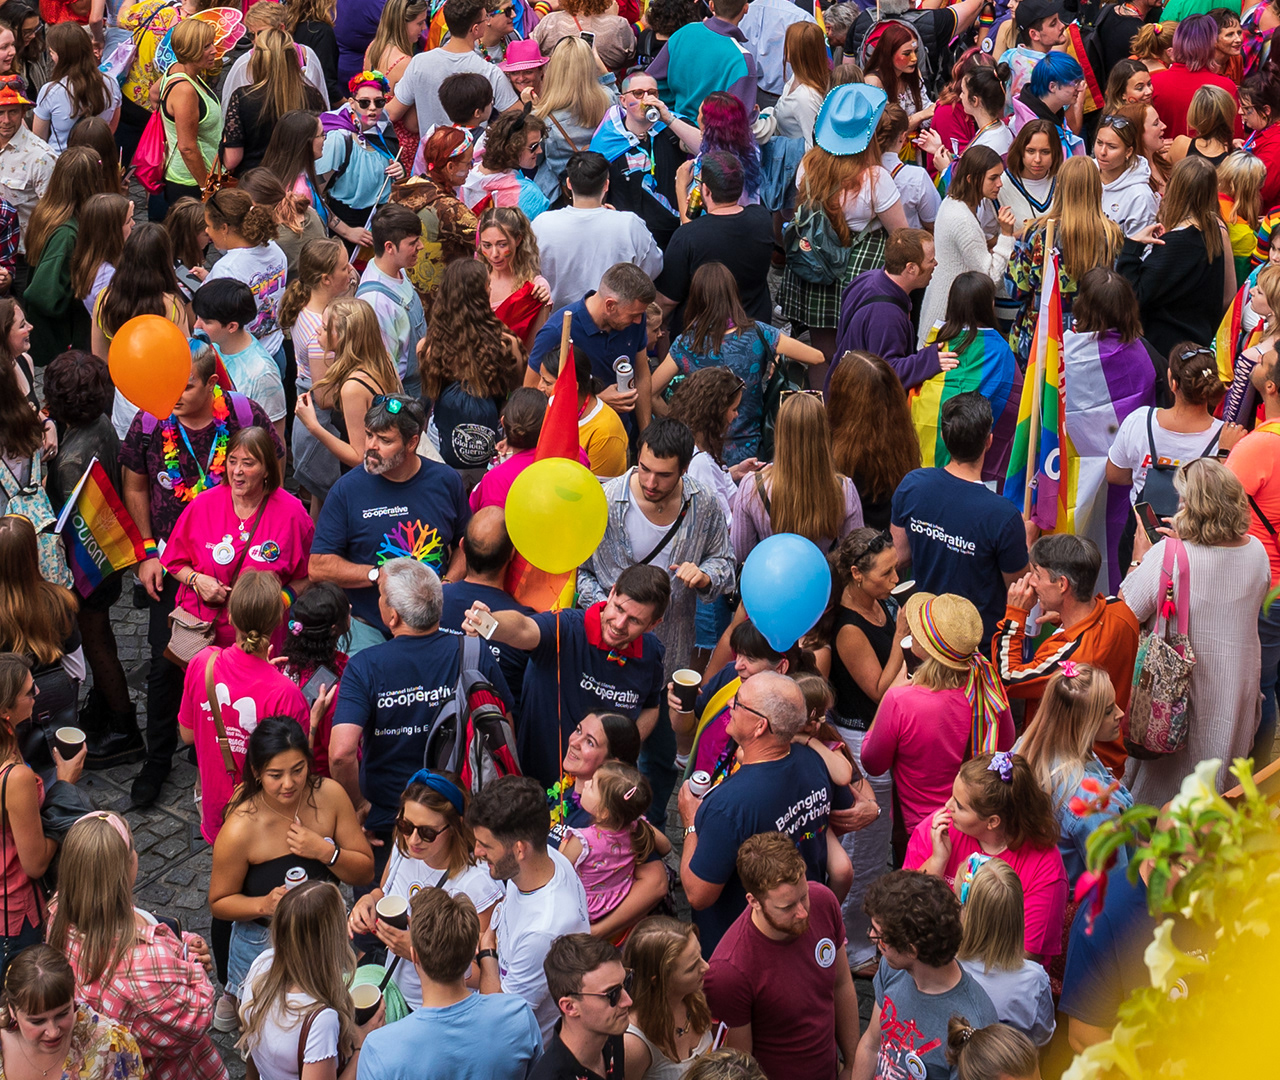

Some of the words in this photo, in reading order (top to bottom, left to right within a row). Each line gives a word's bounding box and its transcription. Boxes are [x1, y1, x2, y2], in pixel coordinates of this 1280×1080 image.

[386, 687, 406, 696] Channel
[406, 685, 424, 693] Islands
[375, 724, 413, 736] Belonging
[414, 725, 421, 733] is
[775, 787, 827, 832] Belonging
